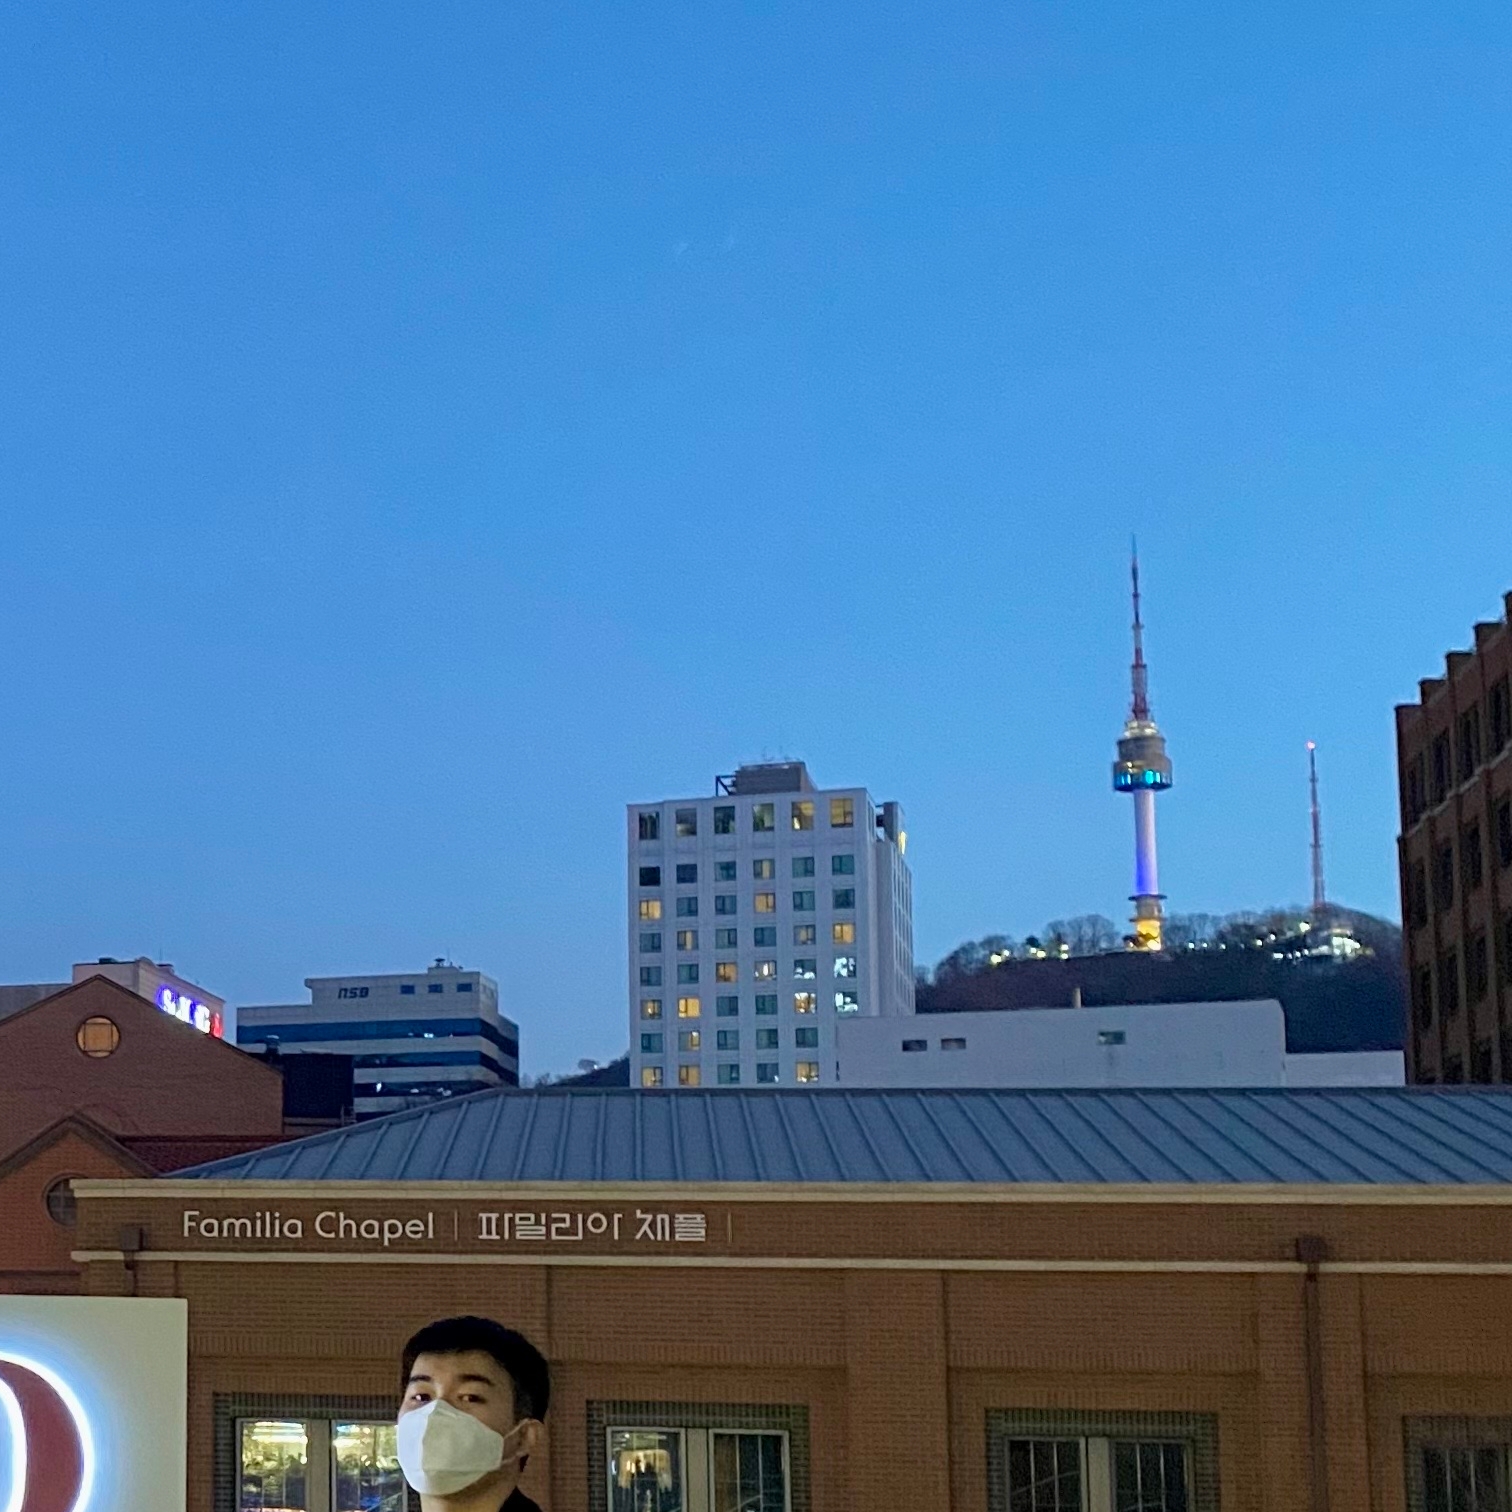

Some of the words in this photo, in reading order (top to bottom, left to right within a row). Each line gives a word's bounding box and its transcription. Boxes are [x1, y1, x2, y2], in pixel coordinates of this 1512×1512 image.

[183, 1210, 303, 1238] Familia
[314, 1211, 434, 1246] Chapel
[478, 1212, 623, 1241] 파밀리아
[635, 1208, 707, 1242] 채플
